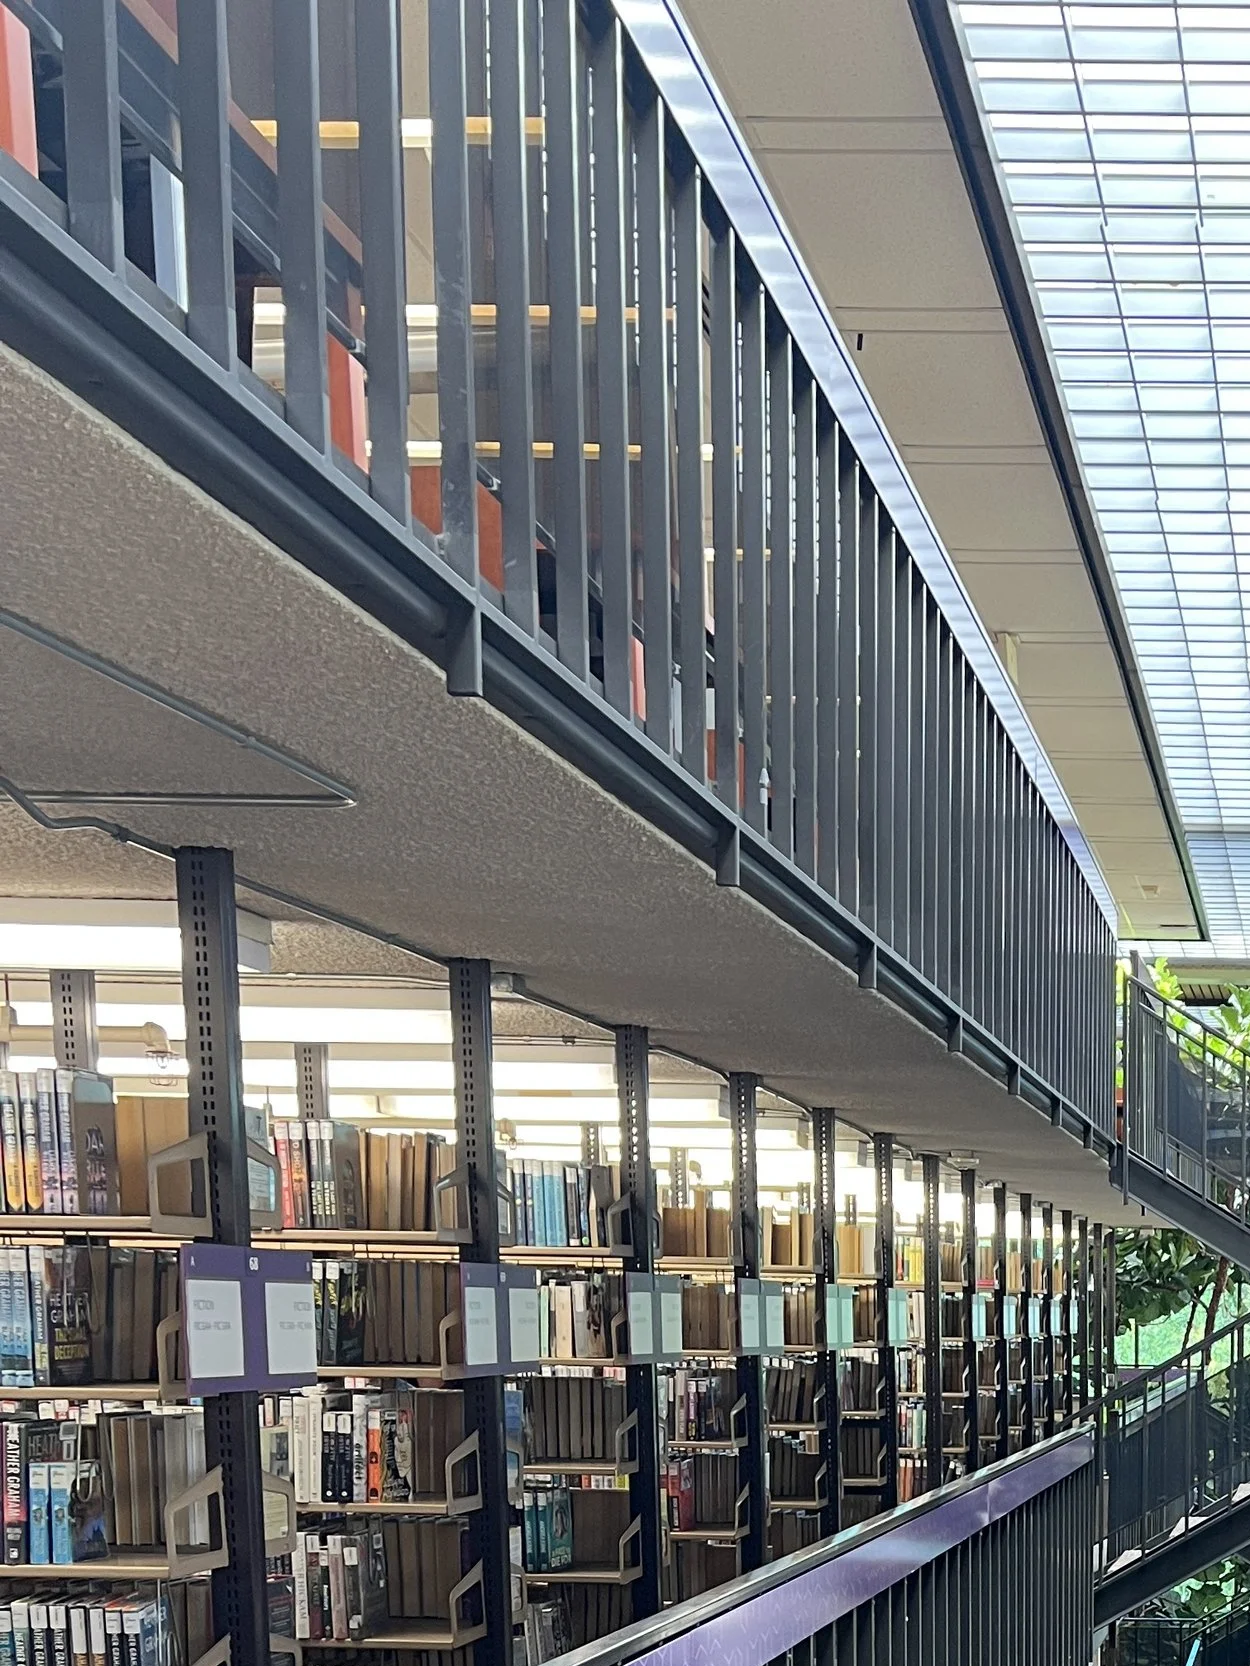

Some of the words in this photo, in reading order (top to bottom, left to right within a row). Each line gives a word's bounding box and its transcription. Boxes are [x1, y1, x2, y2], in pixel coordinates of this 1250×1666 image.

[35, 1305, 44, 1340] GRAHAM
[6, 1474, 21, 1521] GRAHAM
[34, 1628, 45, 1650] ATHER
[54, 1628, 64, 1650] ATHER
